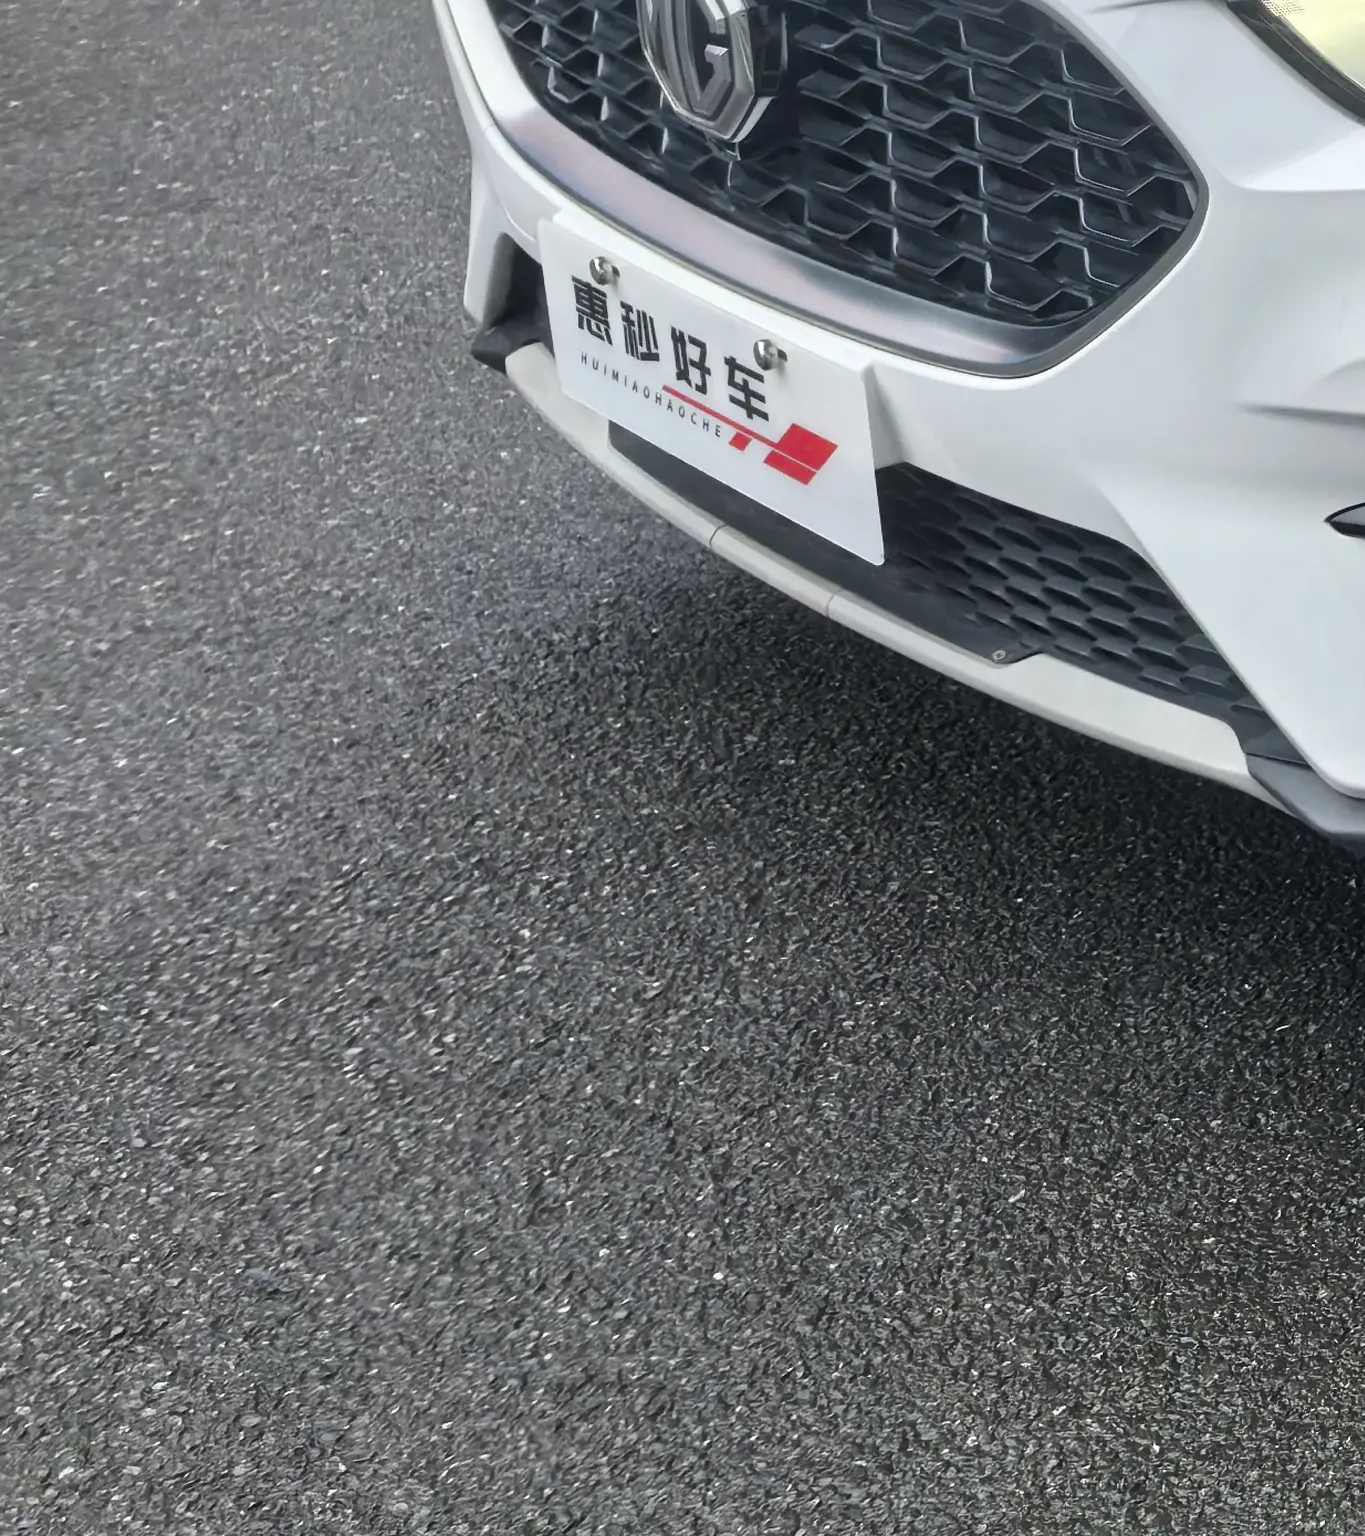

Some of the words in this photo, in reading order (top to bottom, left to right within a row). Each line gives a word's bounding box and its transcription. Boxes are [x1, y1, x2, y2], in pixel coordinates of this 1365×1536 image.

[571, 275, 770, 422] 惠秒好车
[580, 351, 723, 439] HUIMIAOHAOCHE
